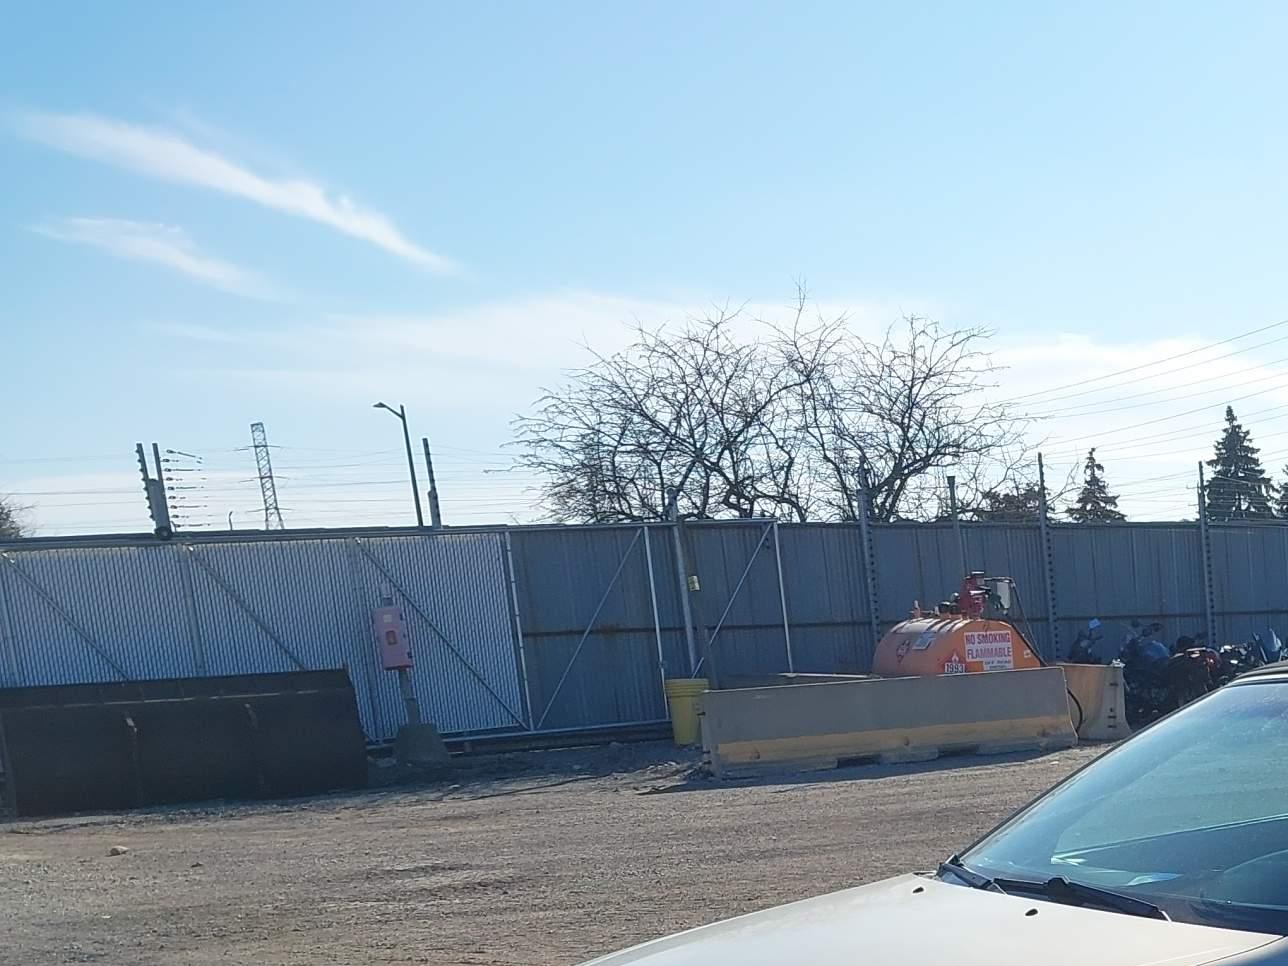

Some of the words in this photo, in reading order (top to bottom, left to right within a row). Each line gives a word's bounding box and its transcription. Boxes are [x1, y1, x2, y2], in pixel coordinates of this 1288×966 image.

[965, 633, 976, 645] NO
[976, 632, 1010, 645] SMOKING
[967, 646, 1012, 660] FLAMMABLE
[946, 663, 965, 673] 1993
